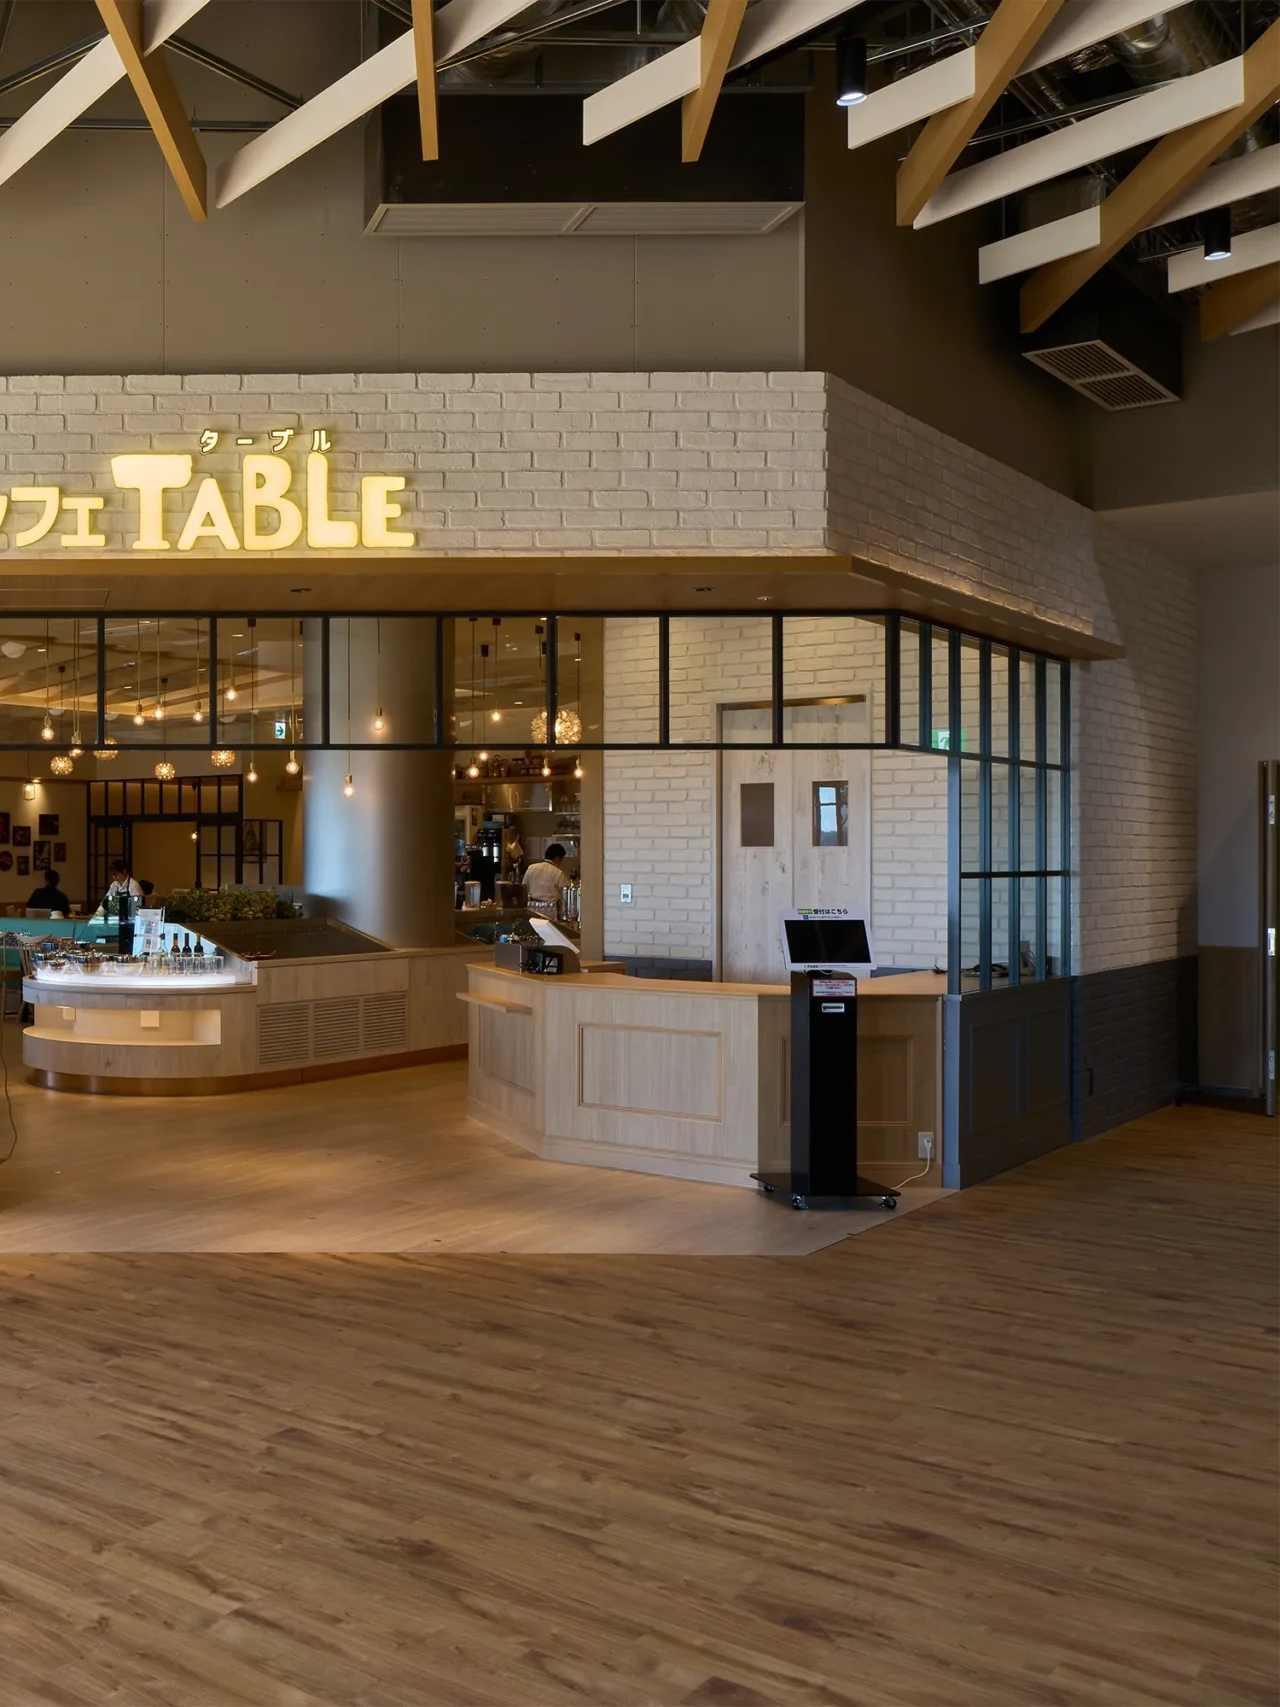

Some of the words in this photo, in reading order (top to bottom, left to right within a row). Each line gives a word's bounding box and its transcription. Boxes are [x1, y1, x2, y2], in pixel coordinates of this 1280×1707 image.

[198, 428, 332, 454] ターブル
[110, 450, 415, 551] TABLE
